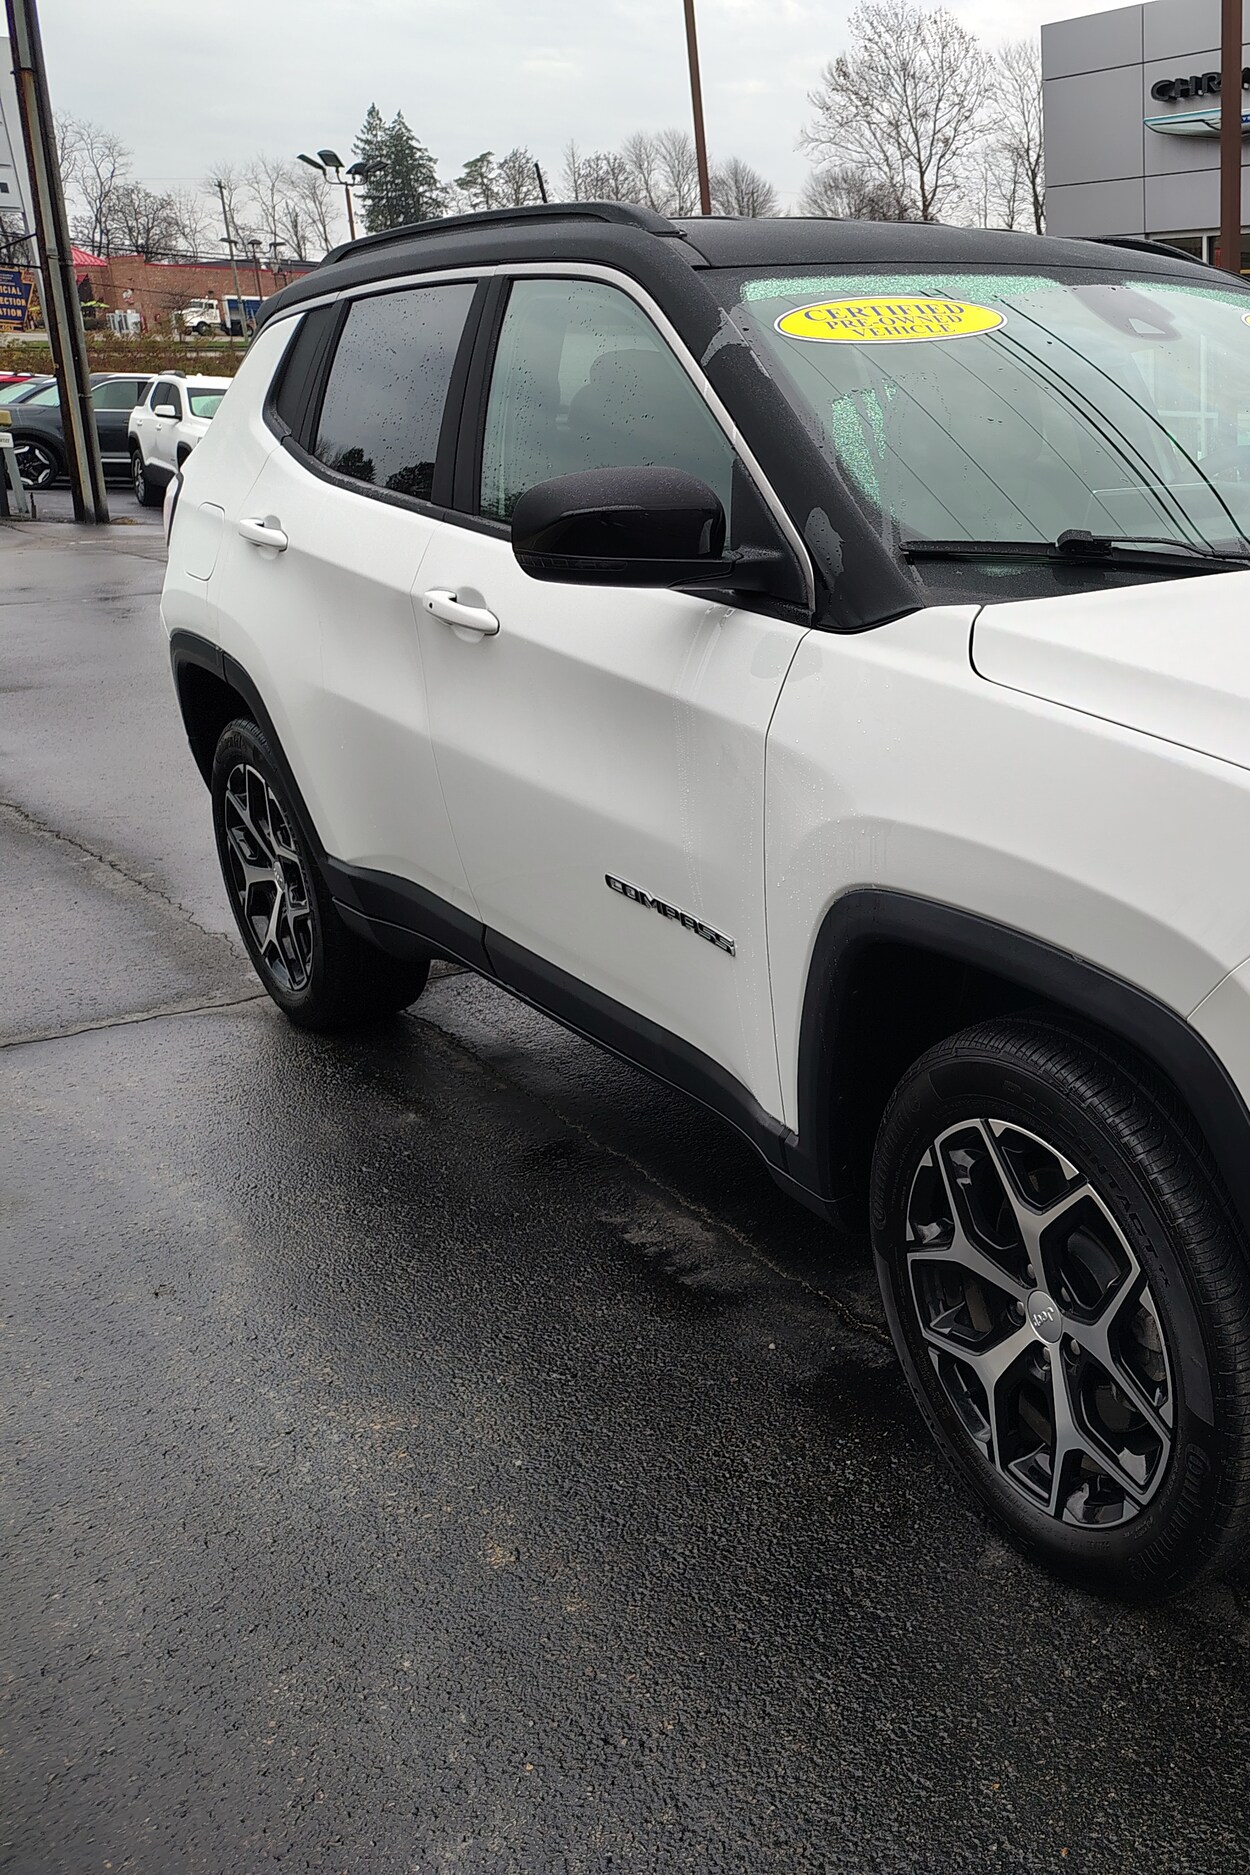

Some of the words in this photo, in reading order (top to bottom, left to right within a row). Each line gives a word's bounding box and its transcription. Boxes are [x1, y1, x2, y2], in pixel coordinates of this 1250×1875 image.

[804, 303, 965, 321] CERTIFIED
[825, 315, 963, 330] PRE-OWNED
[852, 323, 956, 338] VEHICLE
[605, 872, 736, 957] COMPASS
